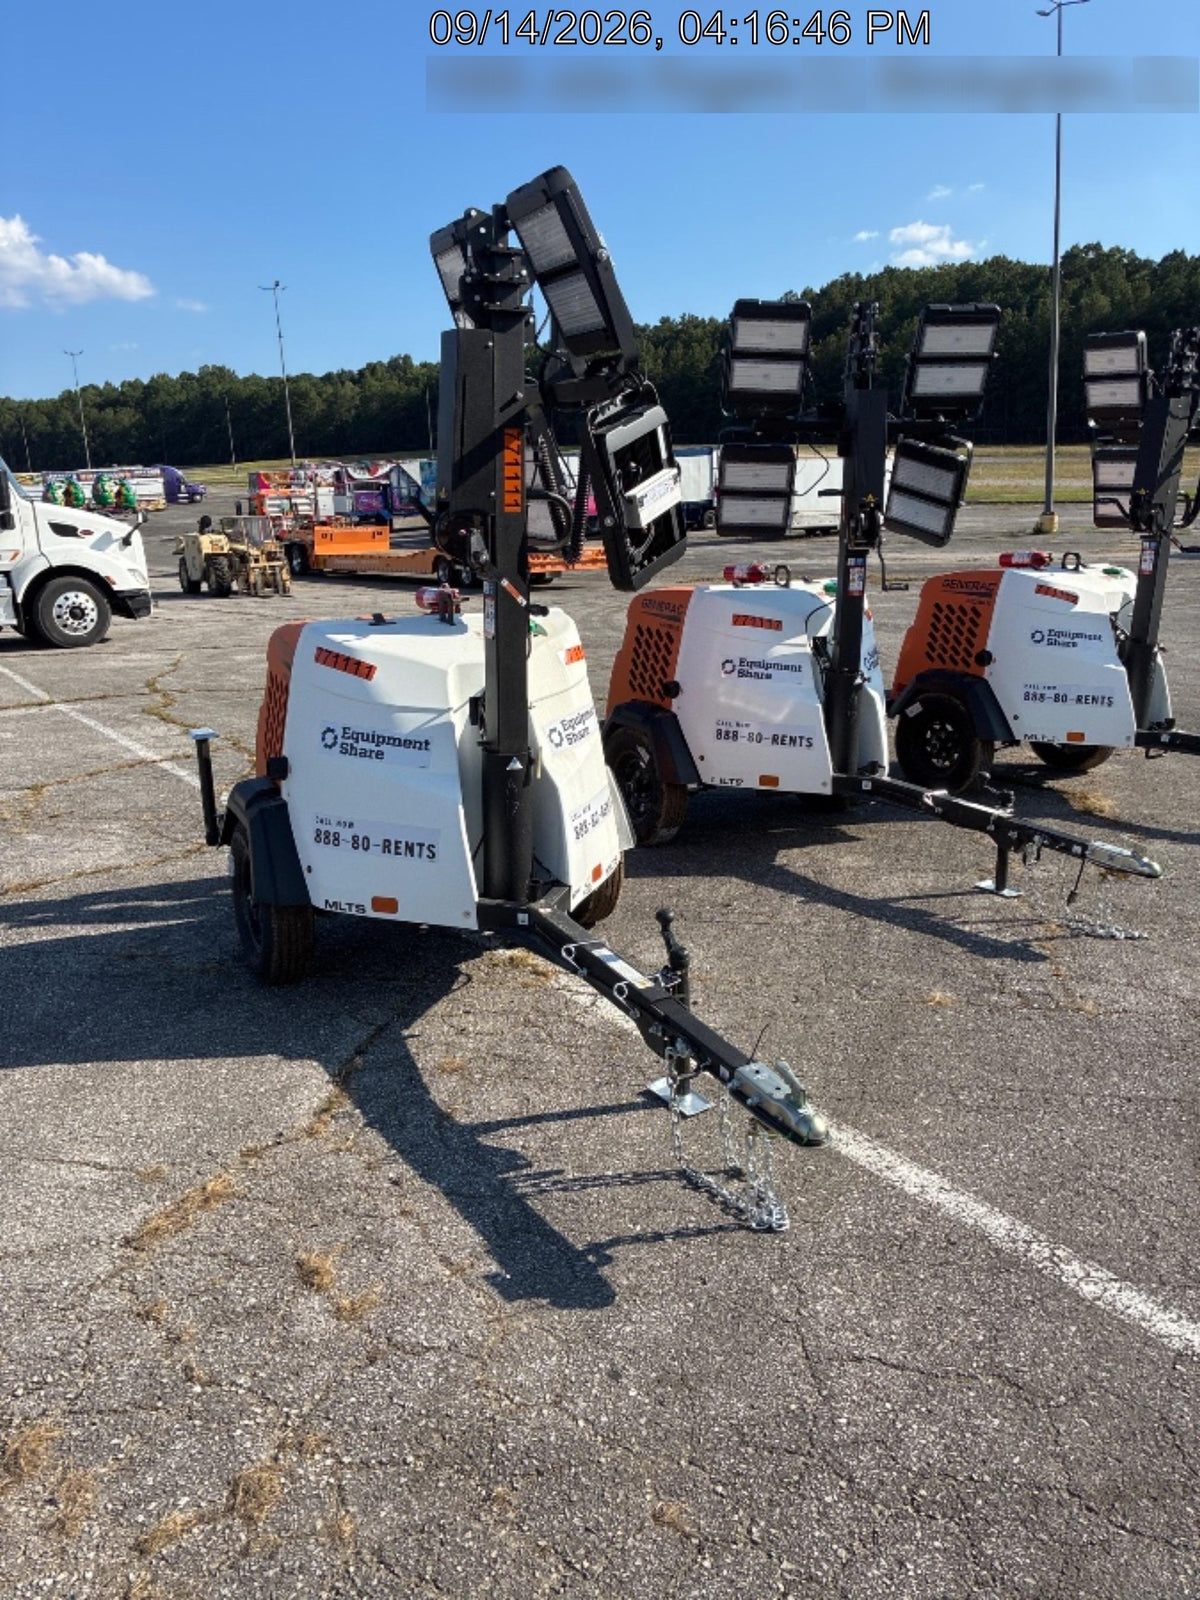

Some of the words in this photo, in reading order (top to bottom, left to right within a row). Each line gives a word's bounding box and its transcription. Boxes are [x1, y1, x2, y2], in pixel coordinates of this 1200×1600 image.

[738, 657, 803, 674] Equipment
[341, 726, 431, 751] Equipment
[716, 728, 814, 748] 888-80-RENTS
[339, 742, 385, 760] Share
[313, 828, 437, 860] 888-80-RENTS
[324, 899, 367, 915] MLTS
